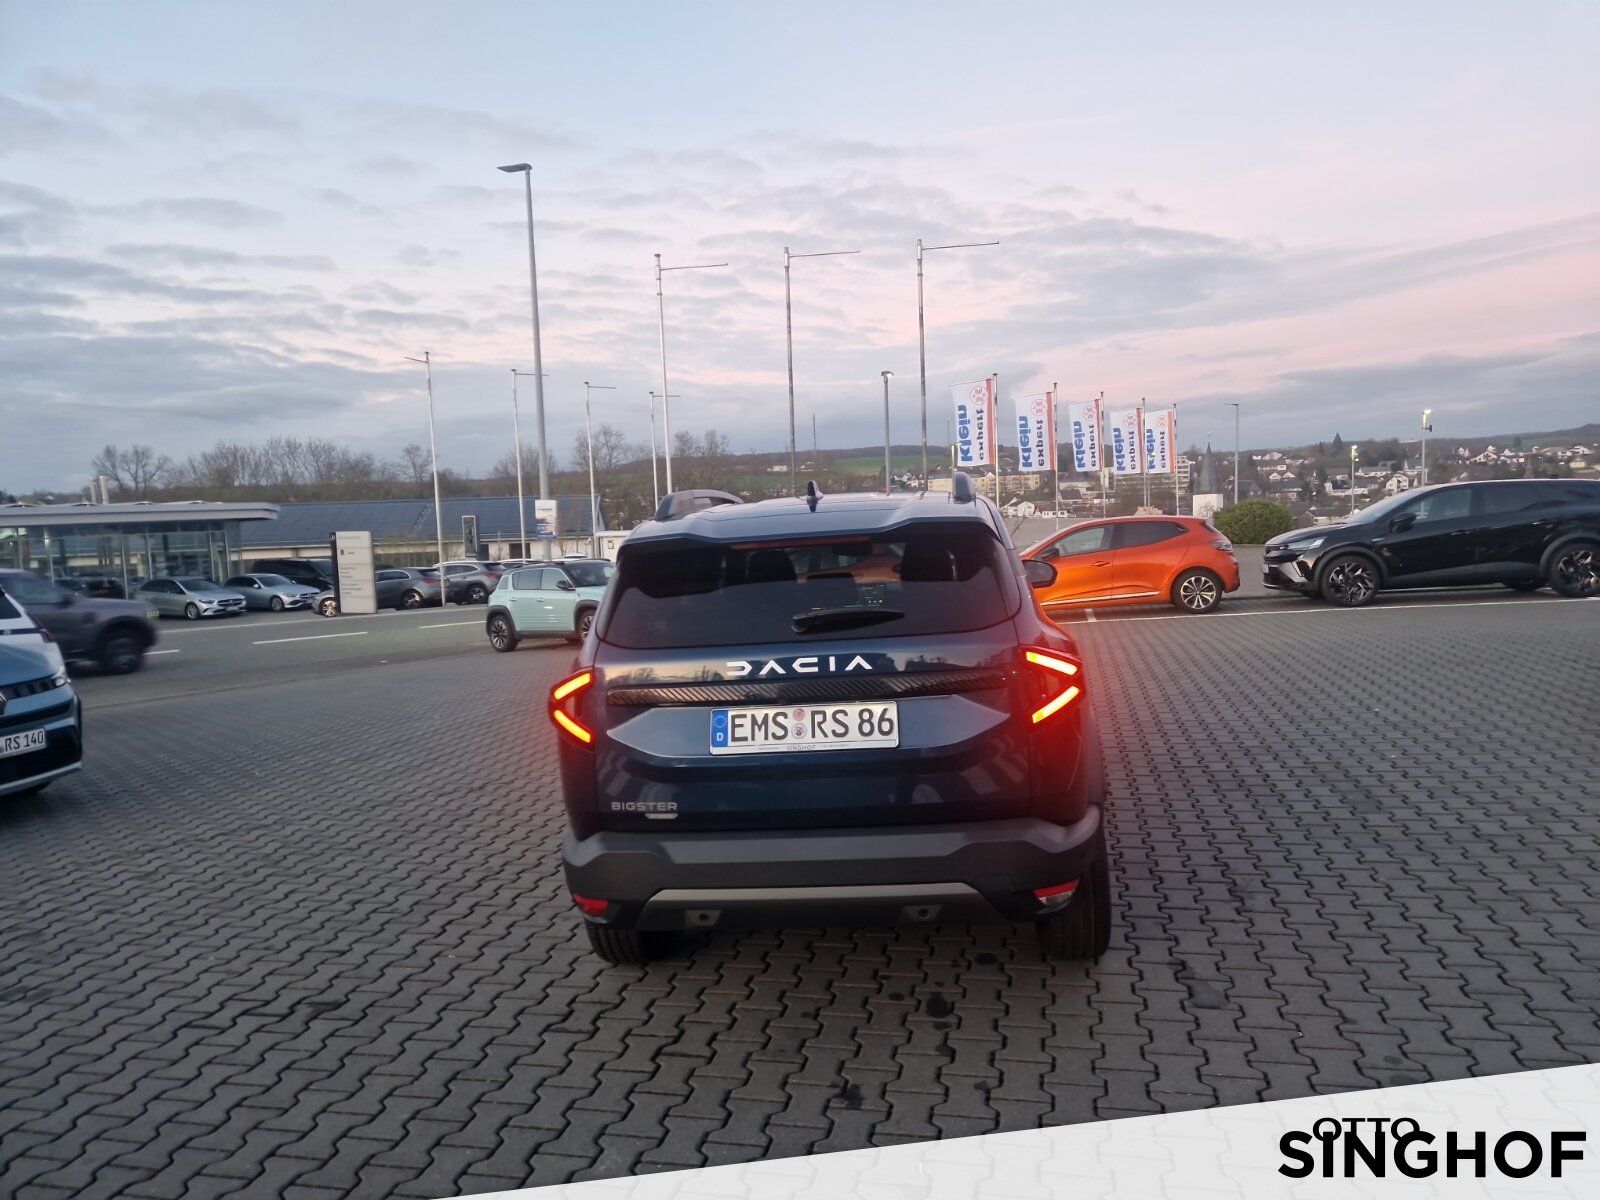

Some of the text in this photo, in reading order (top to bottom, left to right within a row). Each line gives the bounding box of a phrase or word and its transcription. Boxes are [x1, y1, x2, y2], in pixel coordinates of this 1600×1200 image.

[726, 655, 873, 676] DACIA
[716, 707, 894, 743] D EMS RS 86
[5, 730, 44, 752] RS 140
[611, 801, 678, 811] BIGSTER
